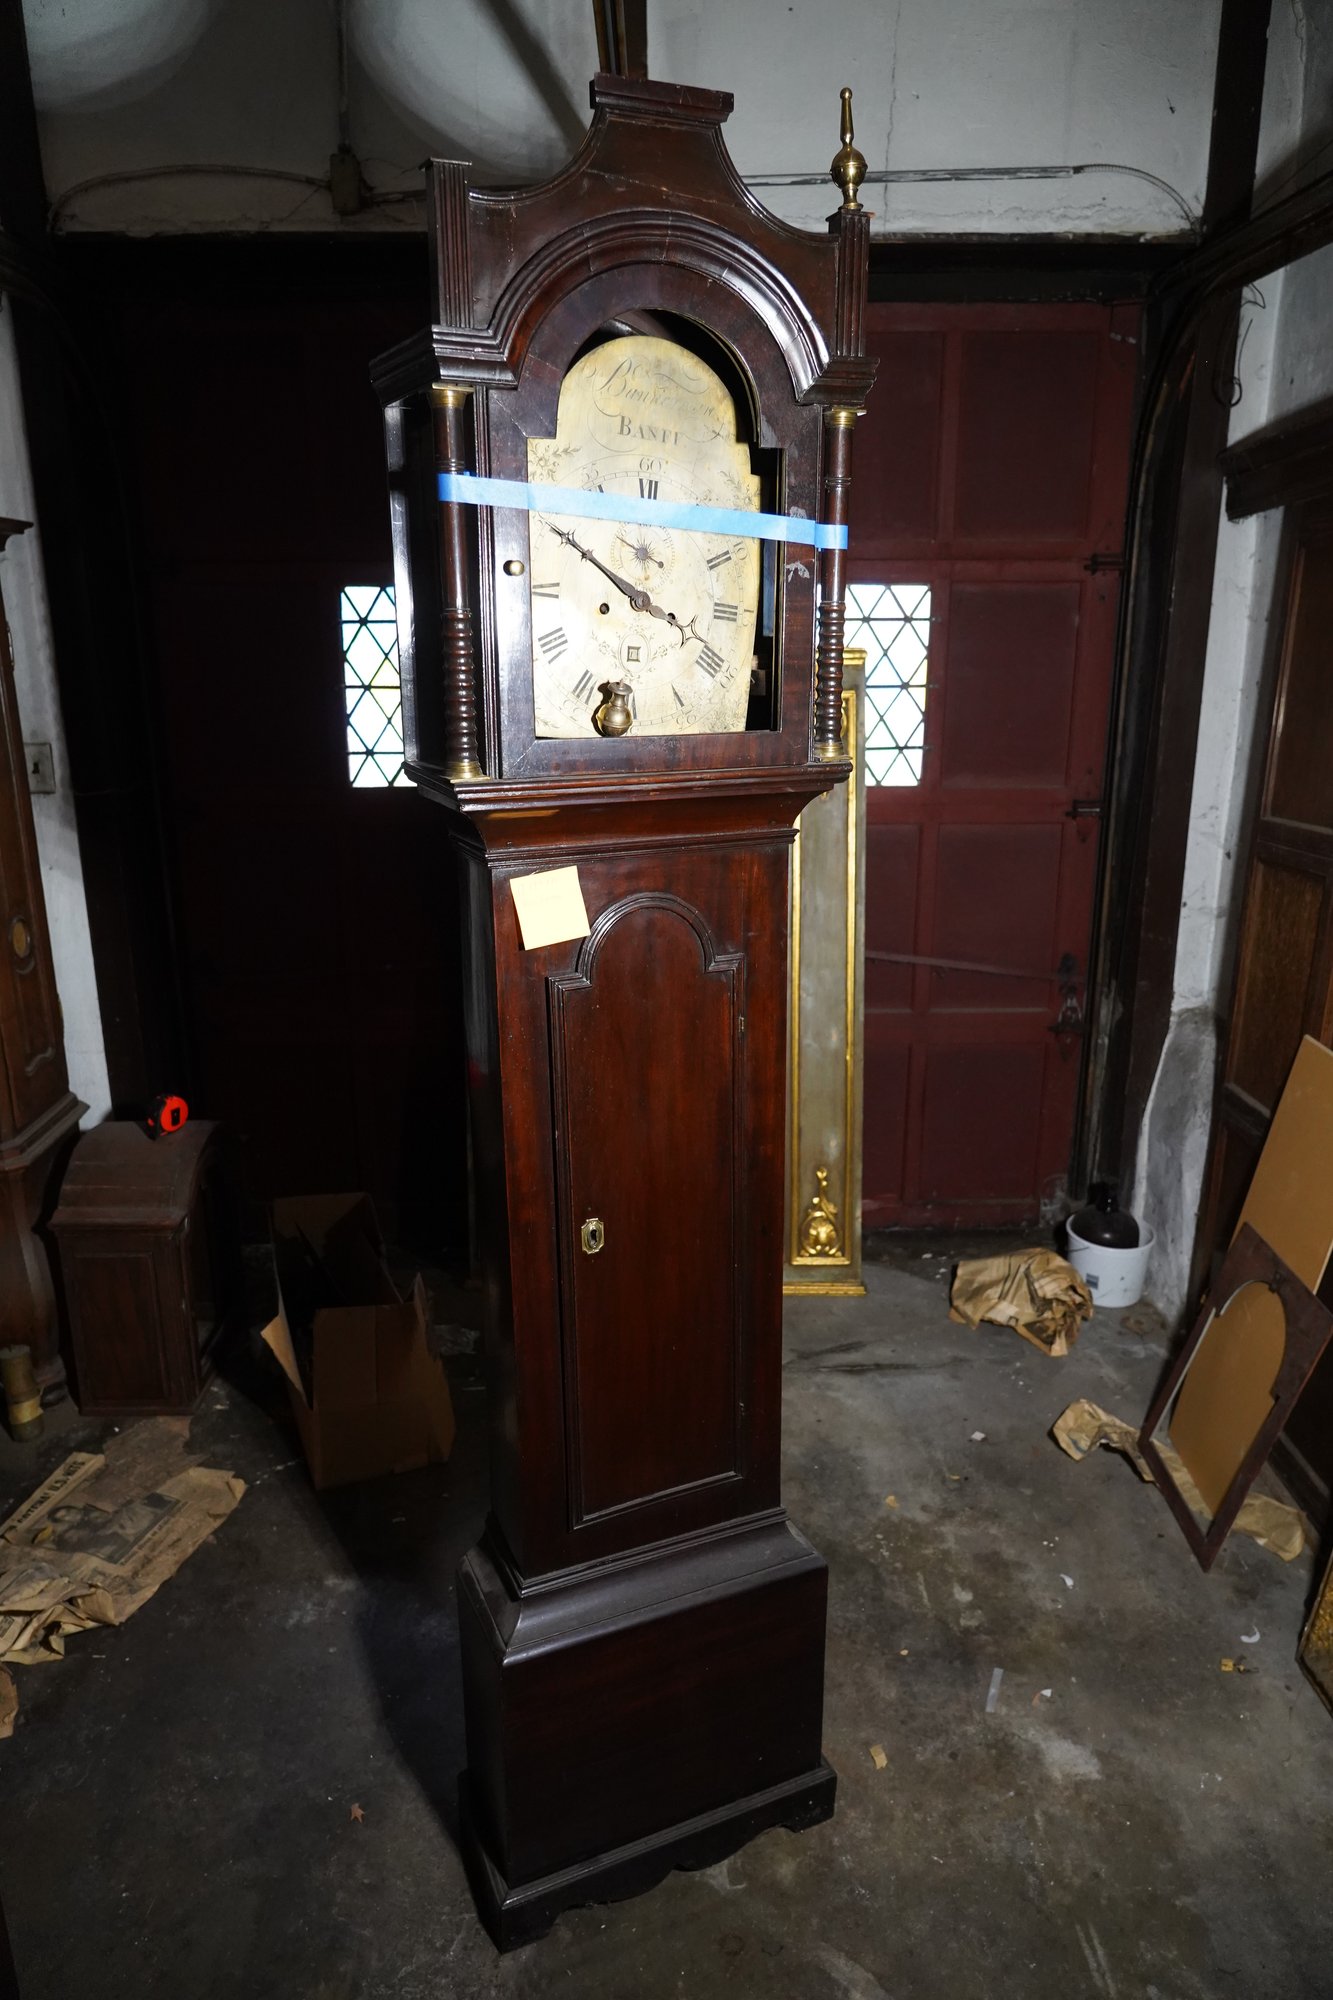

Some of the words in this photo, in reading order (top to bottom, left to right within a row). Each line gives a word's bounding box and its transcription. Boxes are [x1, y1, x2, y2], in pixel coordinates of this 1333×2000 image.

[617, 415, 681, 446] BANFF
[639, 456, 662, 473] 60
[713, 602, 739, 623] III
